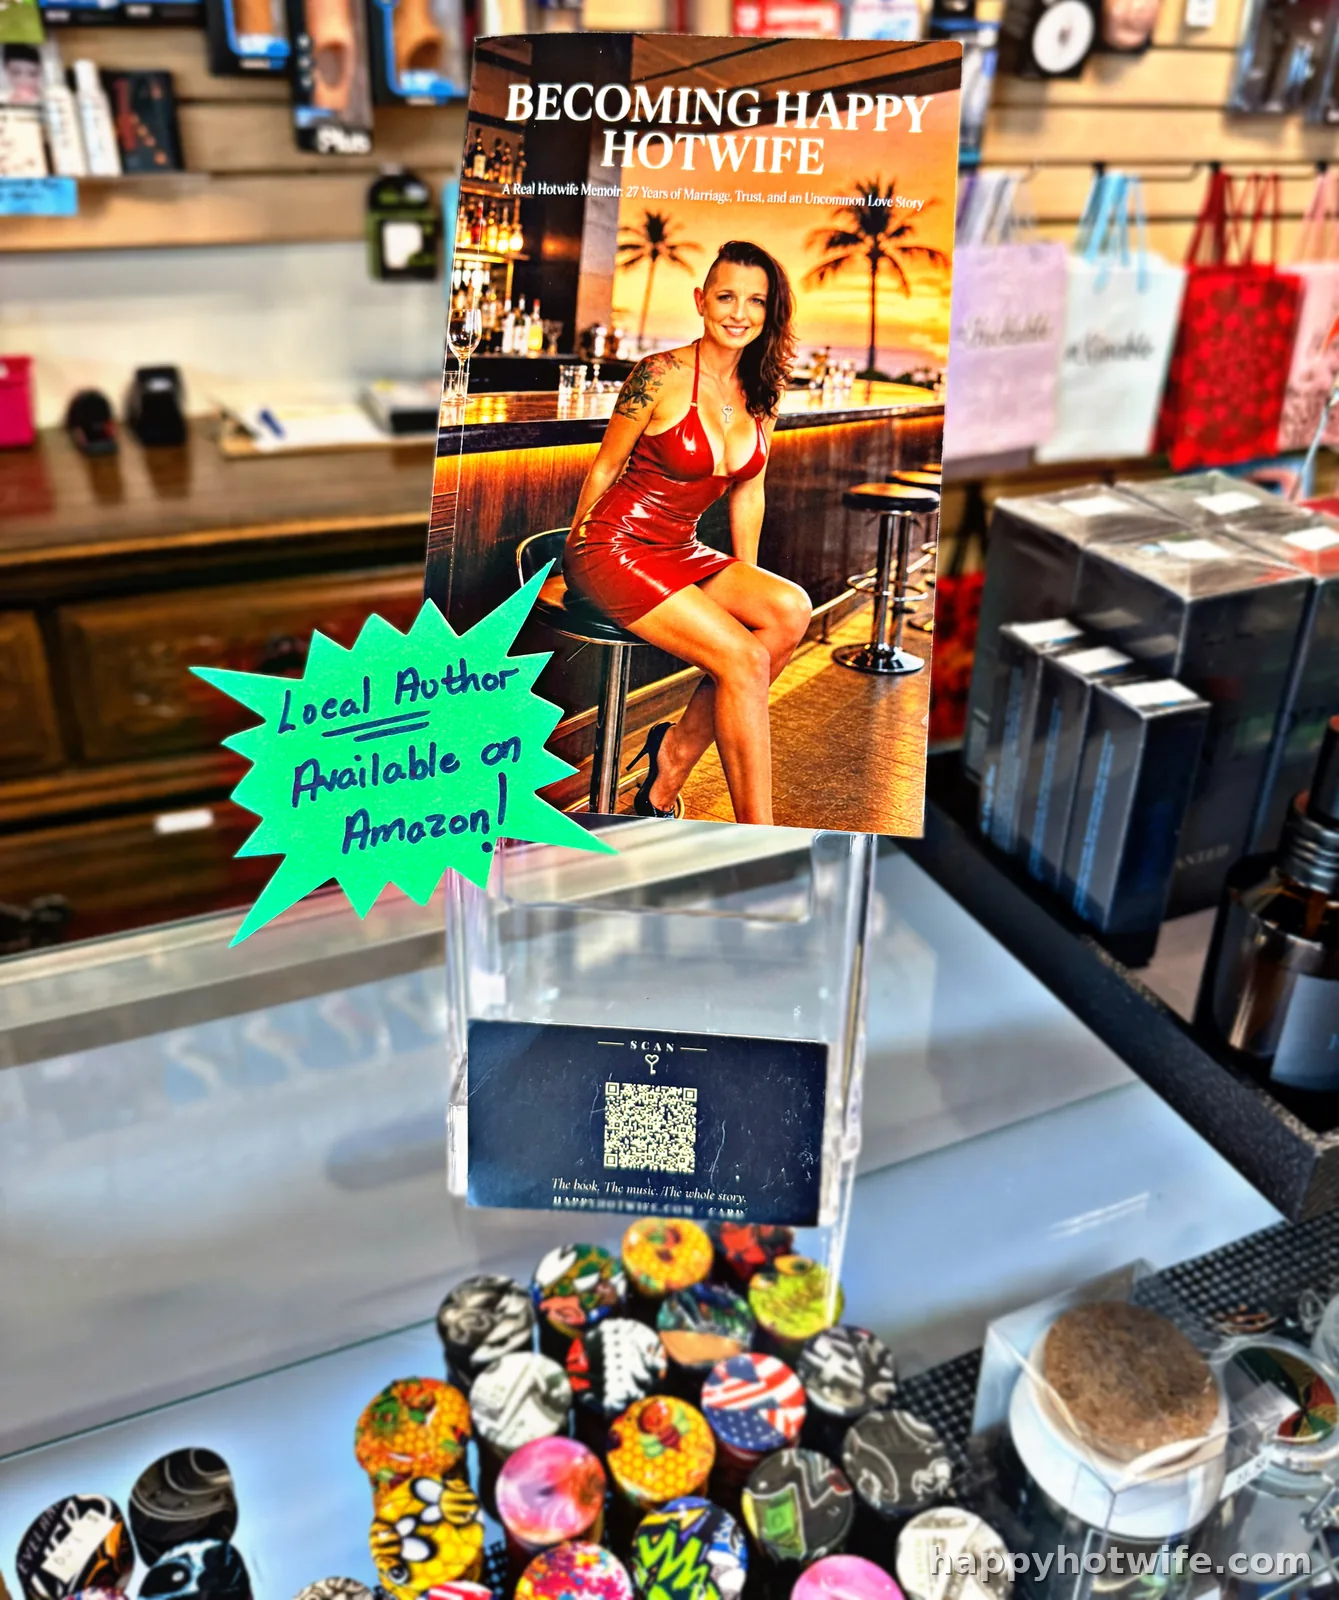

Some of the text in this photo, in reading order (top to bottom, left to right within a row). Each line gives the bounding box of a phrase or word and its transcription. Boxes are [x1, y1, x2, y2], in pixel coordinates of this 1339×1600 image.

[504, 83, 933, 134] BECOMING HAPPY
[601, 129, 825, 175] HOTWIFE
[502, 182, 925, 212] A Real Hotwife Memoir: 27 Years of Marriage, Trust, and an Uncommon Love Story
[277, 657, 520, 735] Local Author
[291, 735, 521, 808] Available on
[341, 772, 507, 855] Amazon!
[630, 1040, 675, 1053] SCAN
[552, 1177, 747, 1206] The book. The music. The whole story.
